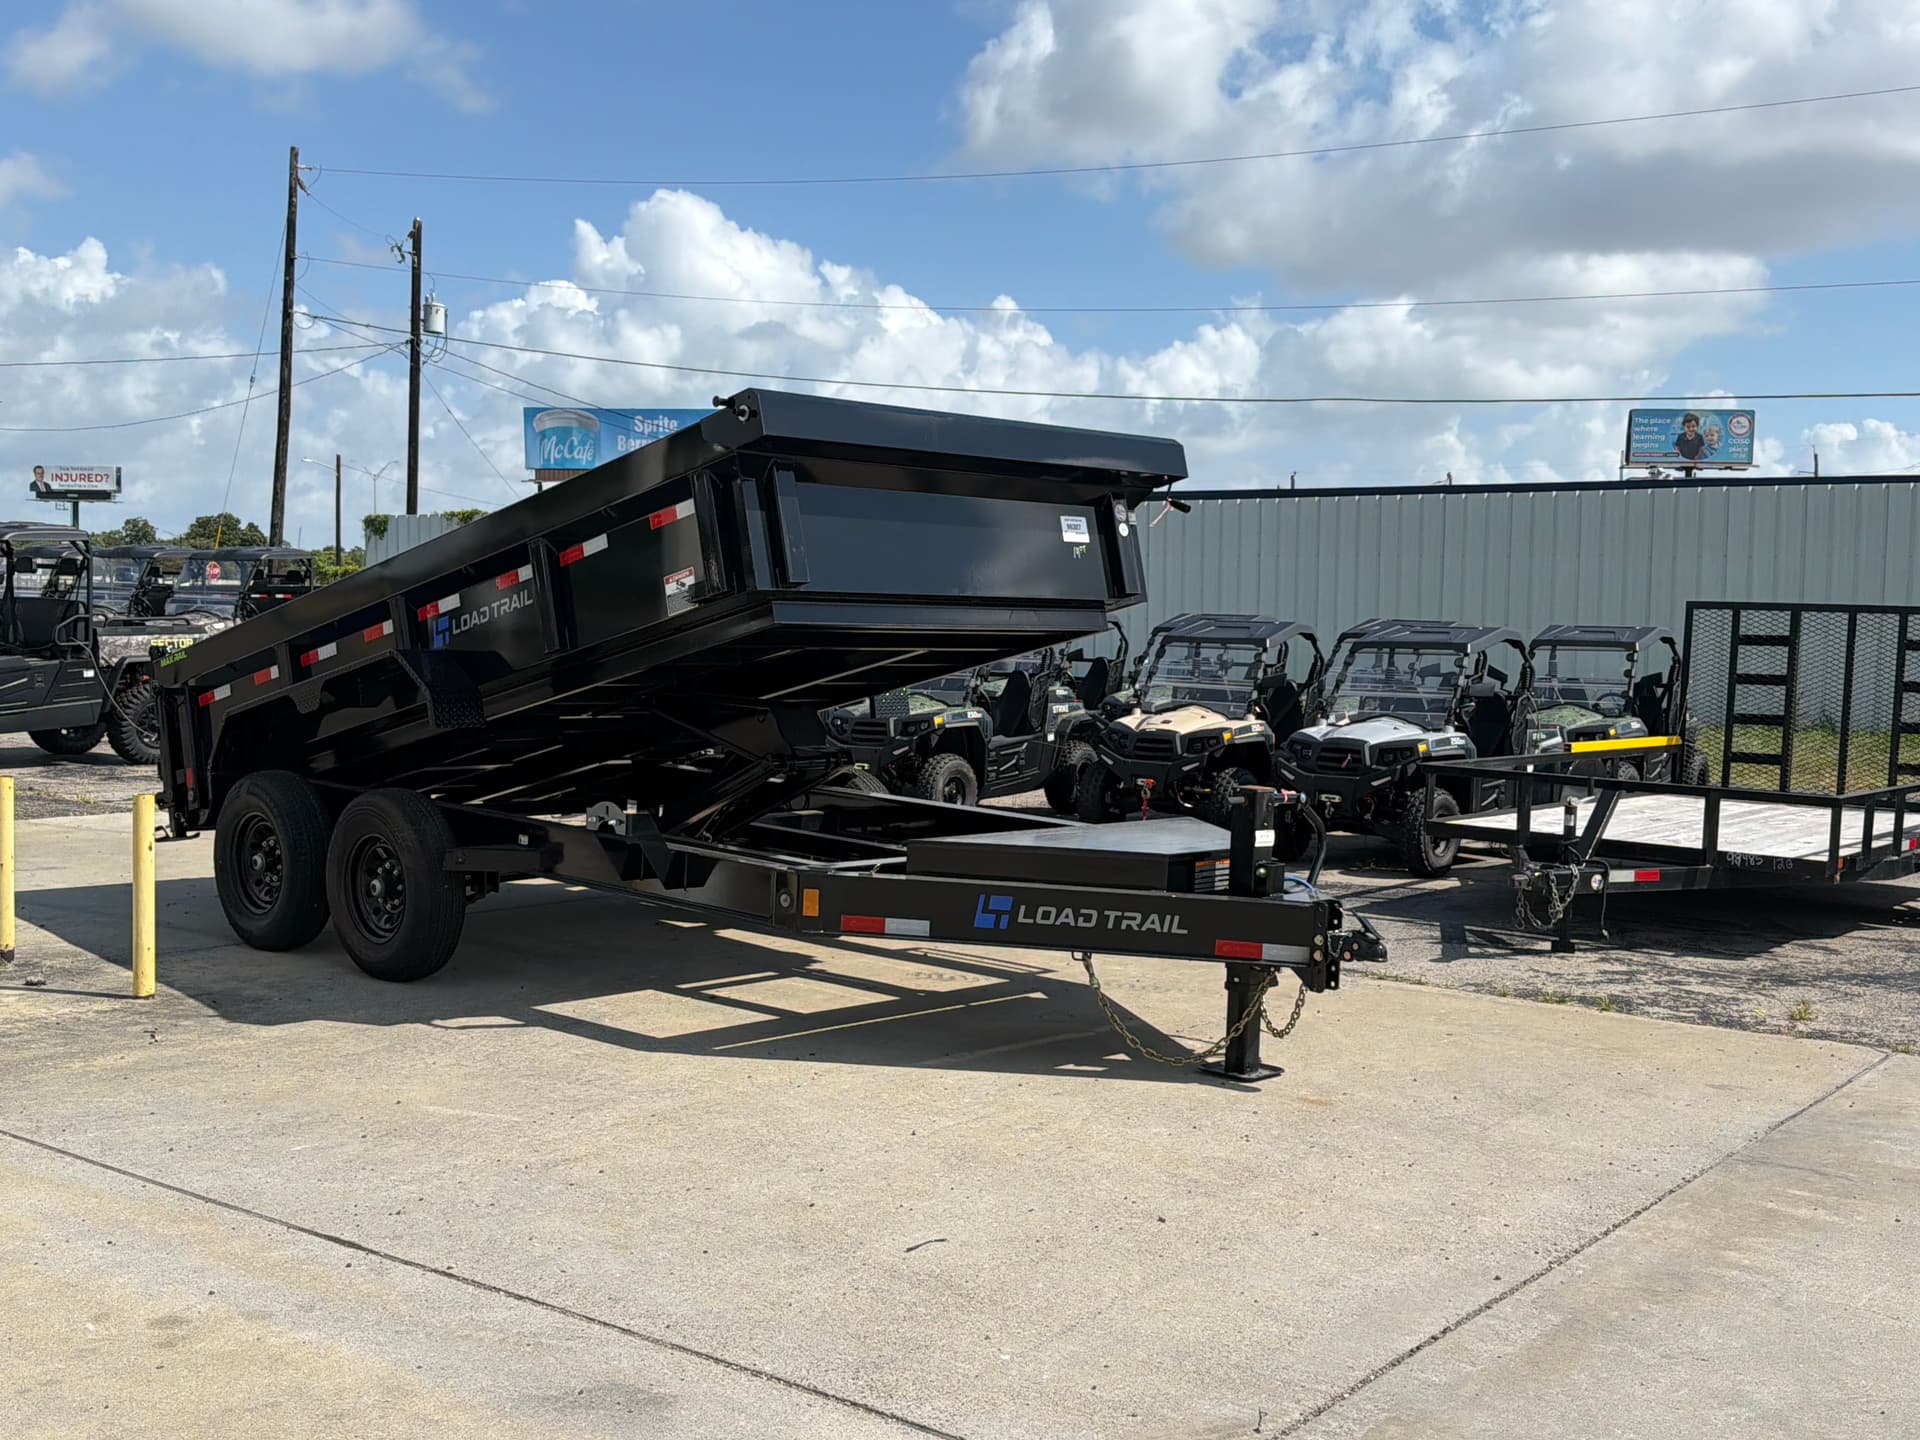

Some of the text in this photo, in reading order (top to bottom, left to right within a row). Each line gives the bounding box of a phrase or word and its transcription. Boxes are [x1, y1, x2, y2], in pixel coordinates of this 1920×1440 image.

[634, 415, 678, 435] Sprite
[539, 435, 595, 465] McCafé
[51, 473, 110, 483] INJURED?
[452, 588, 534, 635] LOAD TRAIL
[1017, 904, 1189, 935] LOAD TRAIL
